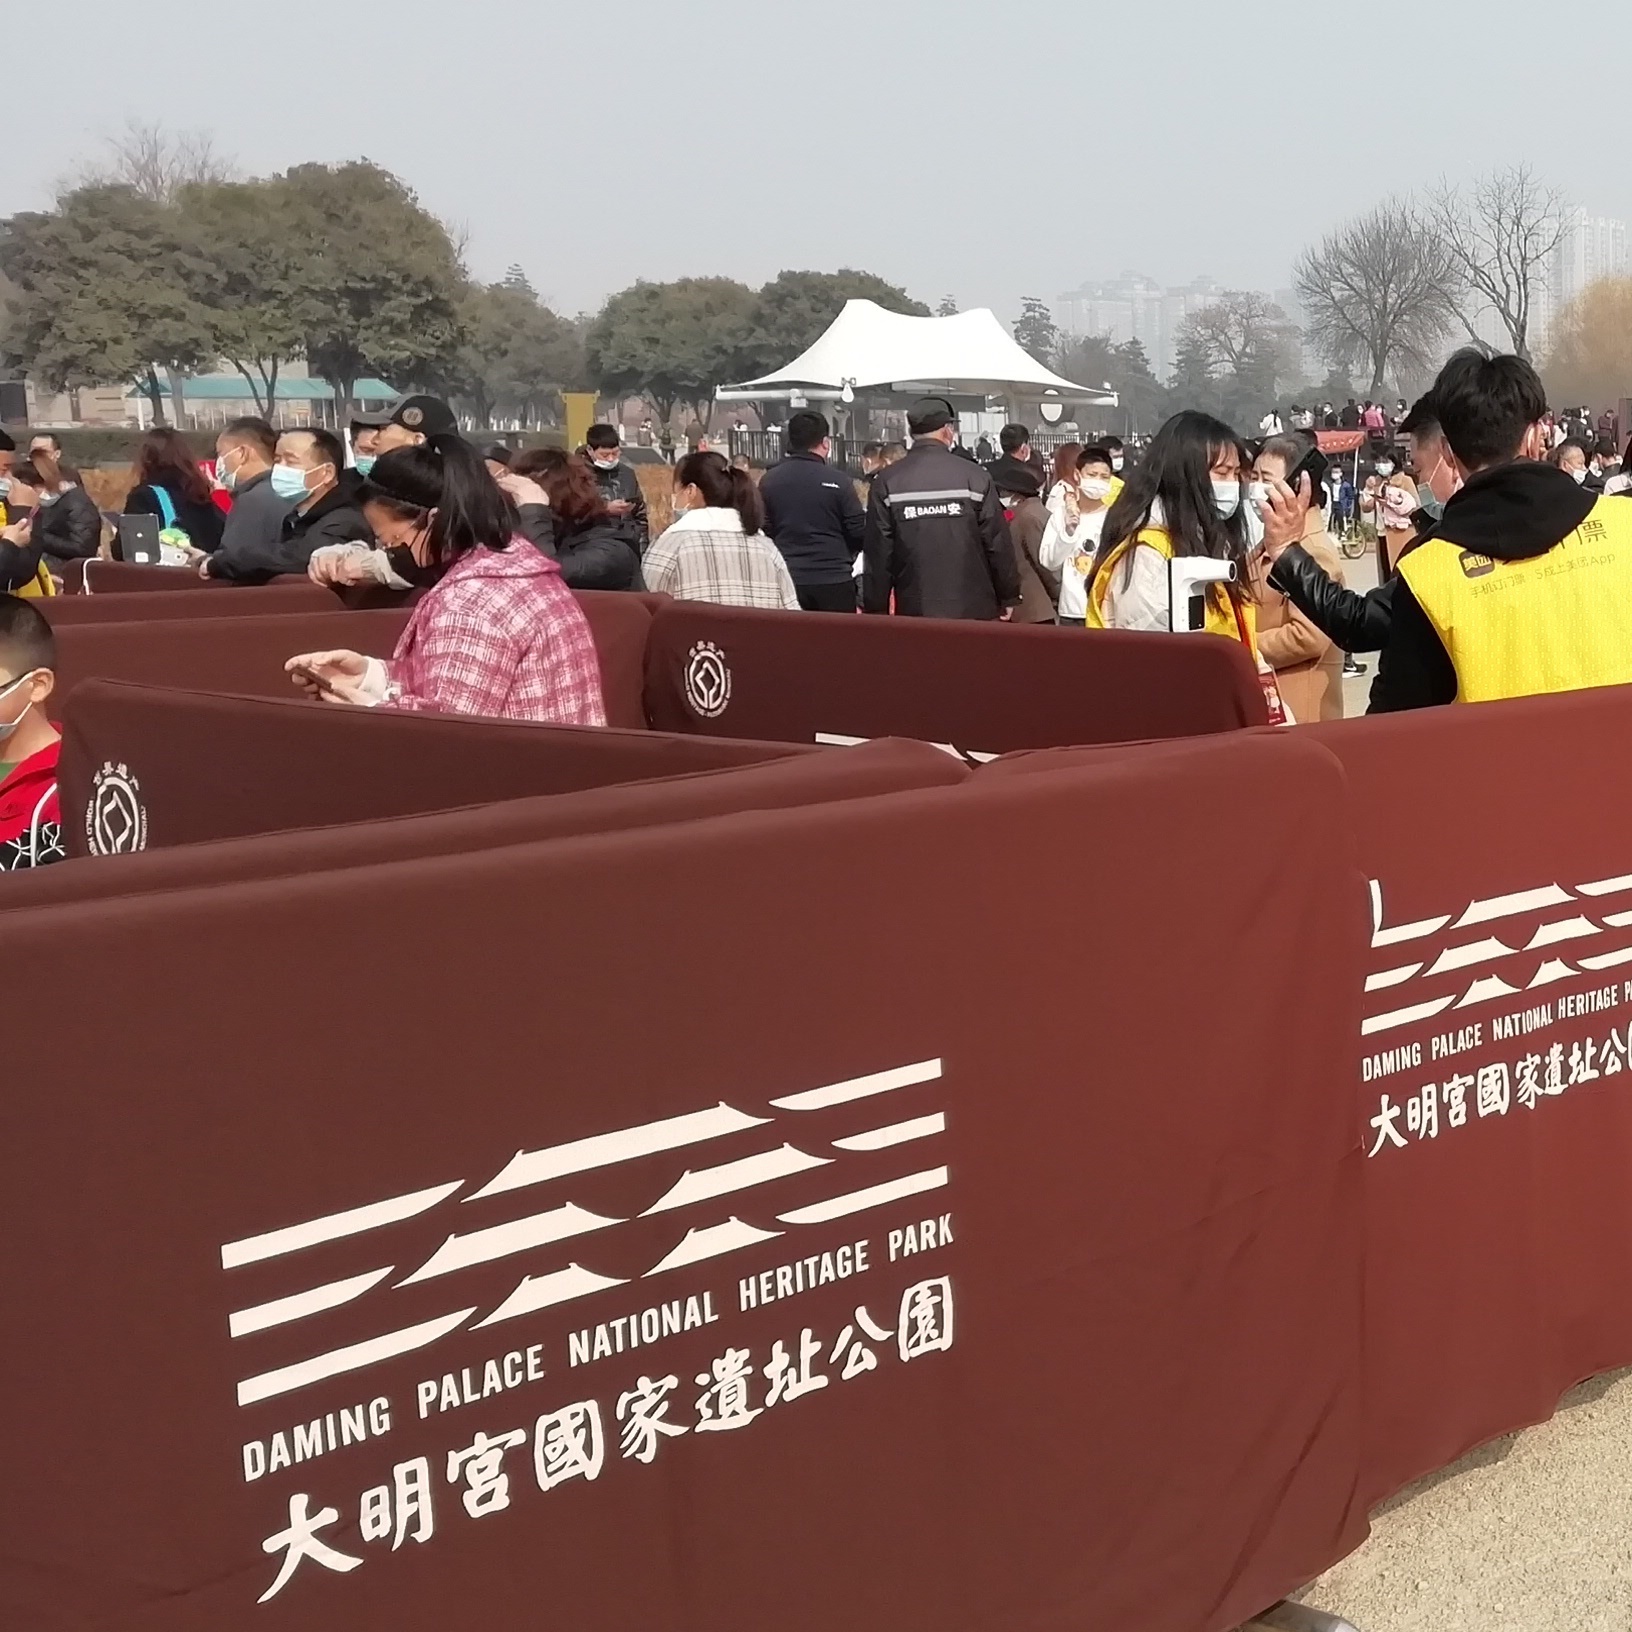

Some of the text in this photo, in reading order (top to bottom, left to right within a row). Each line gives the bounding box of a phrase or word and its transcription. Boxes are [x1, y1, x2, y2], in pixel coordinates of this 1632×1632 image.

[903, 502, 961, 520] 保 BAOAN 安
[1362, 1041, 1422, 1082] DAMING
[1431, 1022, 1484, 1061] PALACE
[1492, 1002, 1554, 1042] NATIONAL
[1557, 983, 1619, 1020] HERITAGE
[242, 1213, 955, 1482] DAMING PALACE NATIONAL HERITAGE PARK
